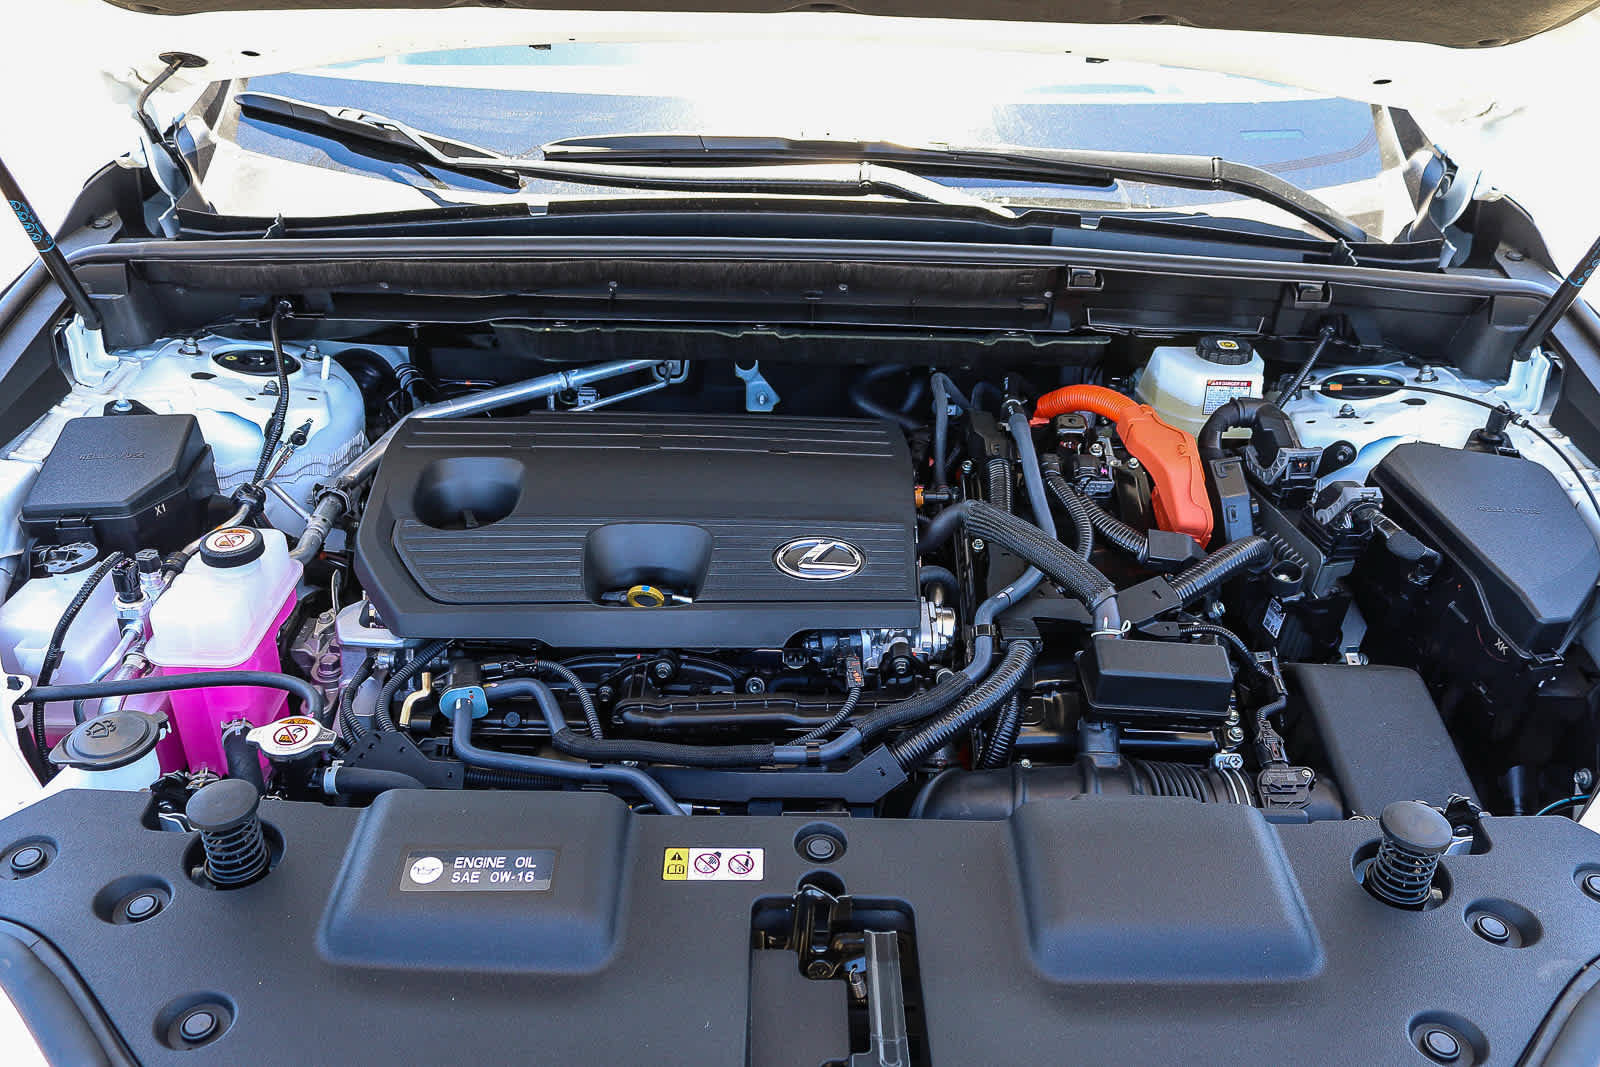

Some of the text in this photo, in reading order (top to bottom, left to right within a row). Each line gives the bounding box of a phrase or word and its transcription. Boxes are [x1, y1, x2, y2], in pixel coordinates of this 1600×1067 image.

[154, 503, 166, 516] X1
[453, 856, 537, 868] ENGINE OIL
[451, 871, 535, 883] SAE 0W-16
